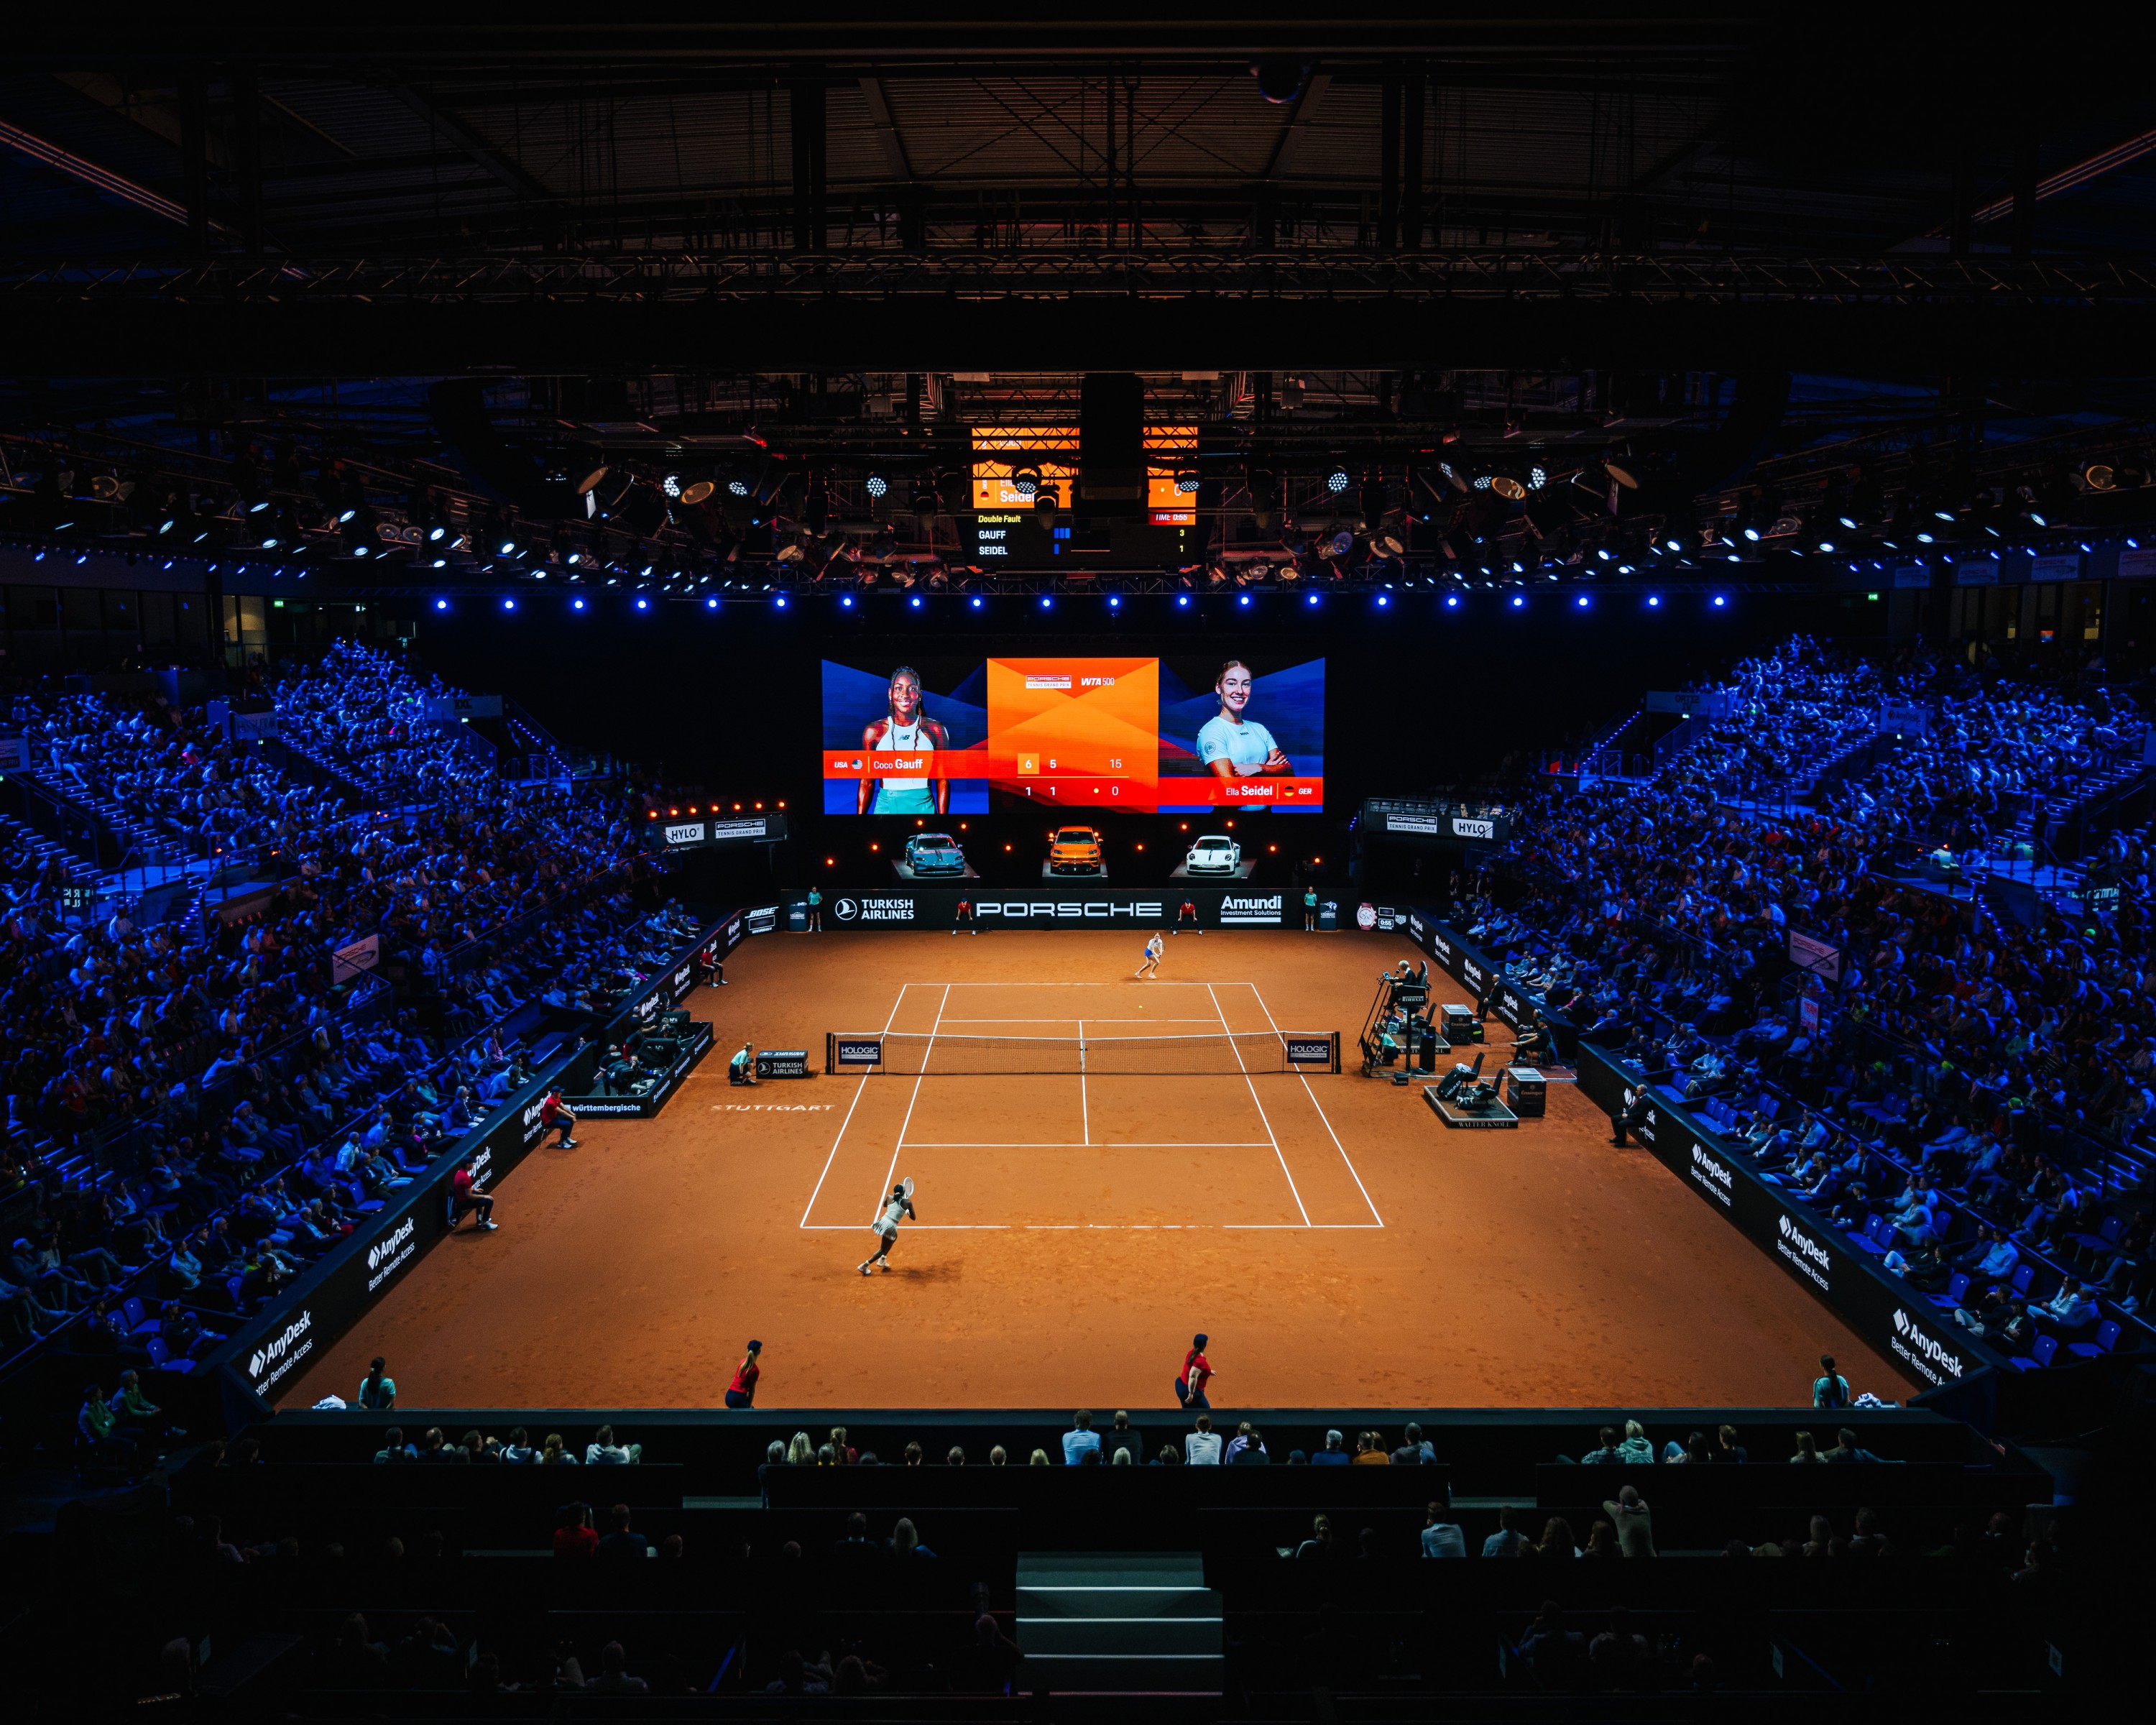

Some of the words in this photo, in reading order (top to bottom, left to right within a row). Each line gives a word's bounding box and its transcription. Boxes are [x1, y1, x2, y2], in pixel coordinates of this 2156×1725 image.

[979, 530, 1006, 540] GAUFF
[980, 546, 1008, 555] SEIDEL
[1081, 677, 1102, 686] WTA
[1102, 677, 1115, 686] 500
[873, 760, 893, 769] Coco
[895, 759, 923, 769] Gauff
[1025, 759, 1032, 768] 6
[1049, 759, 1056, 768] 5
[1110, 759, 1122, 768] 15
[1026, 786, 1031, 796] 1
[1050, 786, 1056, 796] 1
[1112, 786, 1119, 796] 0
[1241, 786, 1273, 796] Seidel
[671, 827, 697, 840] HYLO
[1458, 822, 1485, 834] HYLO
[861, 899, 913, 909] TURKISH
[1221, 896, 1282, 909] Amundi
[746, 906, 778, 918] BOSE
[861, 910, 914, 919] AIRLINES
[976, 903, 1162, 916] PORSCHE
[1446, 1080, 1462, 1096] HEAD
[572, 1104, 641, 1113] württembergische
[1702, 1152, 1732, 1189] AnyDesk
[1691, 1165, 1703, 1182] Better
[1702, 1175, 1717, 1195] Remote
[1717, 1188, 1731, 1206] Access
[380, 1217, 414, 1260] AnyDesk
[1791, 1226, 1830, 1271] AnyDesk
[369, 1271, 384, 1292] Better
[383, 1256, 401, 1278] Remote
[400, 1242, 415, 1262] Access
[1777, 1238, 1792, 1259] Better
[1792, 1252, 1811, 1276] Remote
[1811, 1269, 1828, 1292] Access
[267, 1310, 311, 1365] AnyDesk
[1909, 1323, 1963, 1378] AnyDesk
[1892, 1335, 1911, 1361] Better
[1912, 1353, 1937, 1384] Remote
[255, 1378, 270, 1397] tter
[270, 1357, 293, 1385] Remote
[293, 1338, 313, 1363] Access
